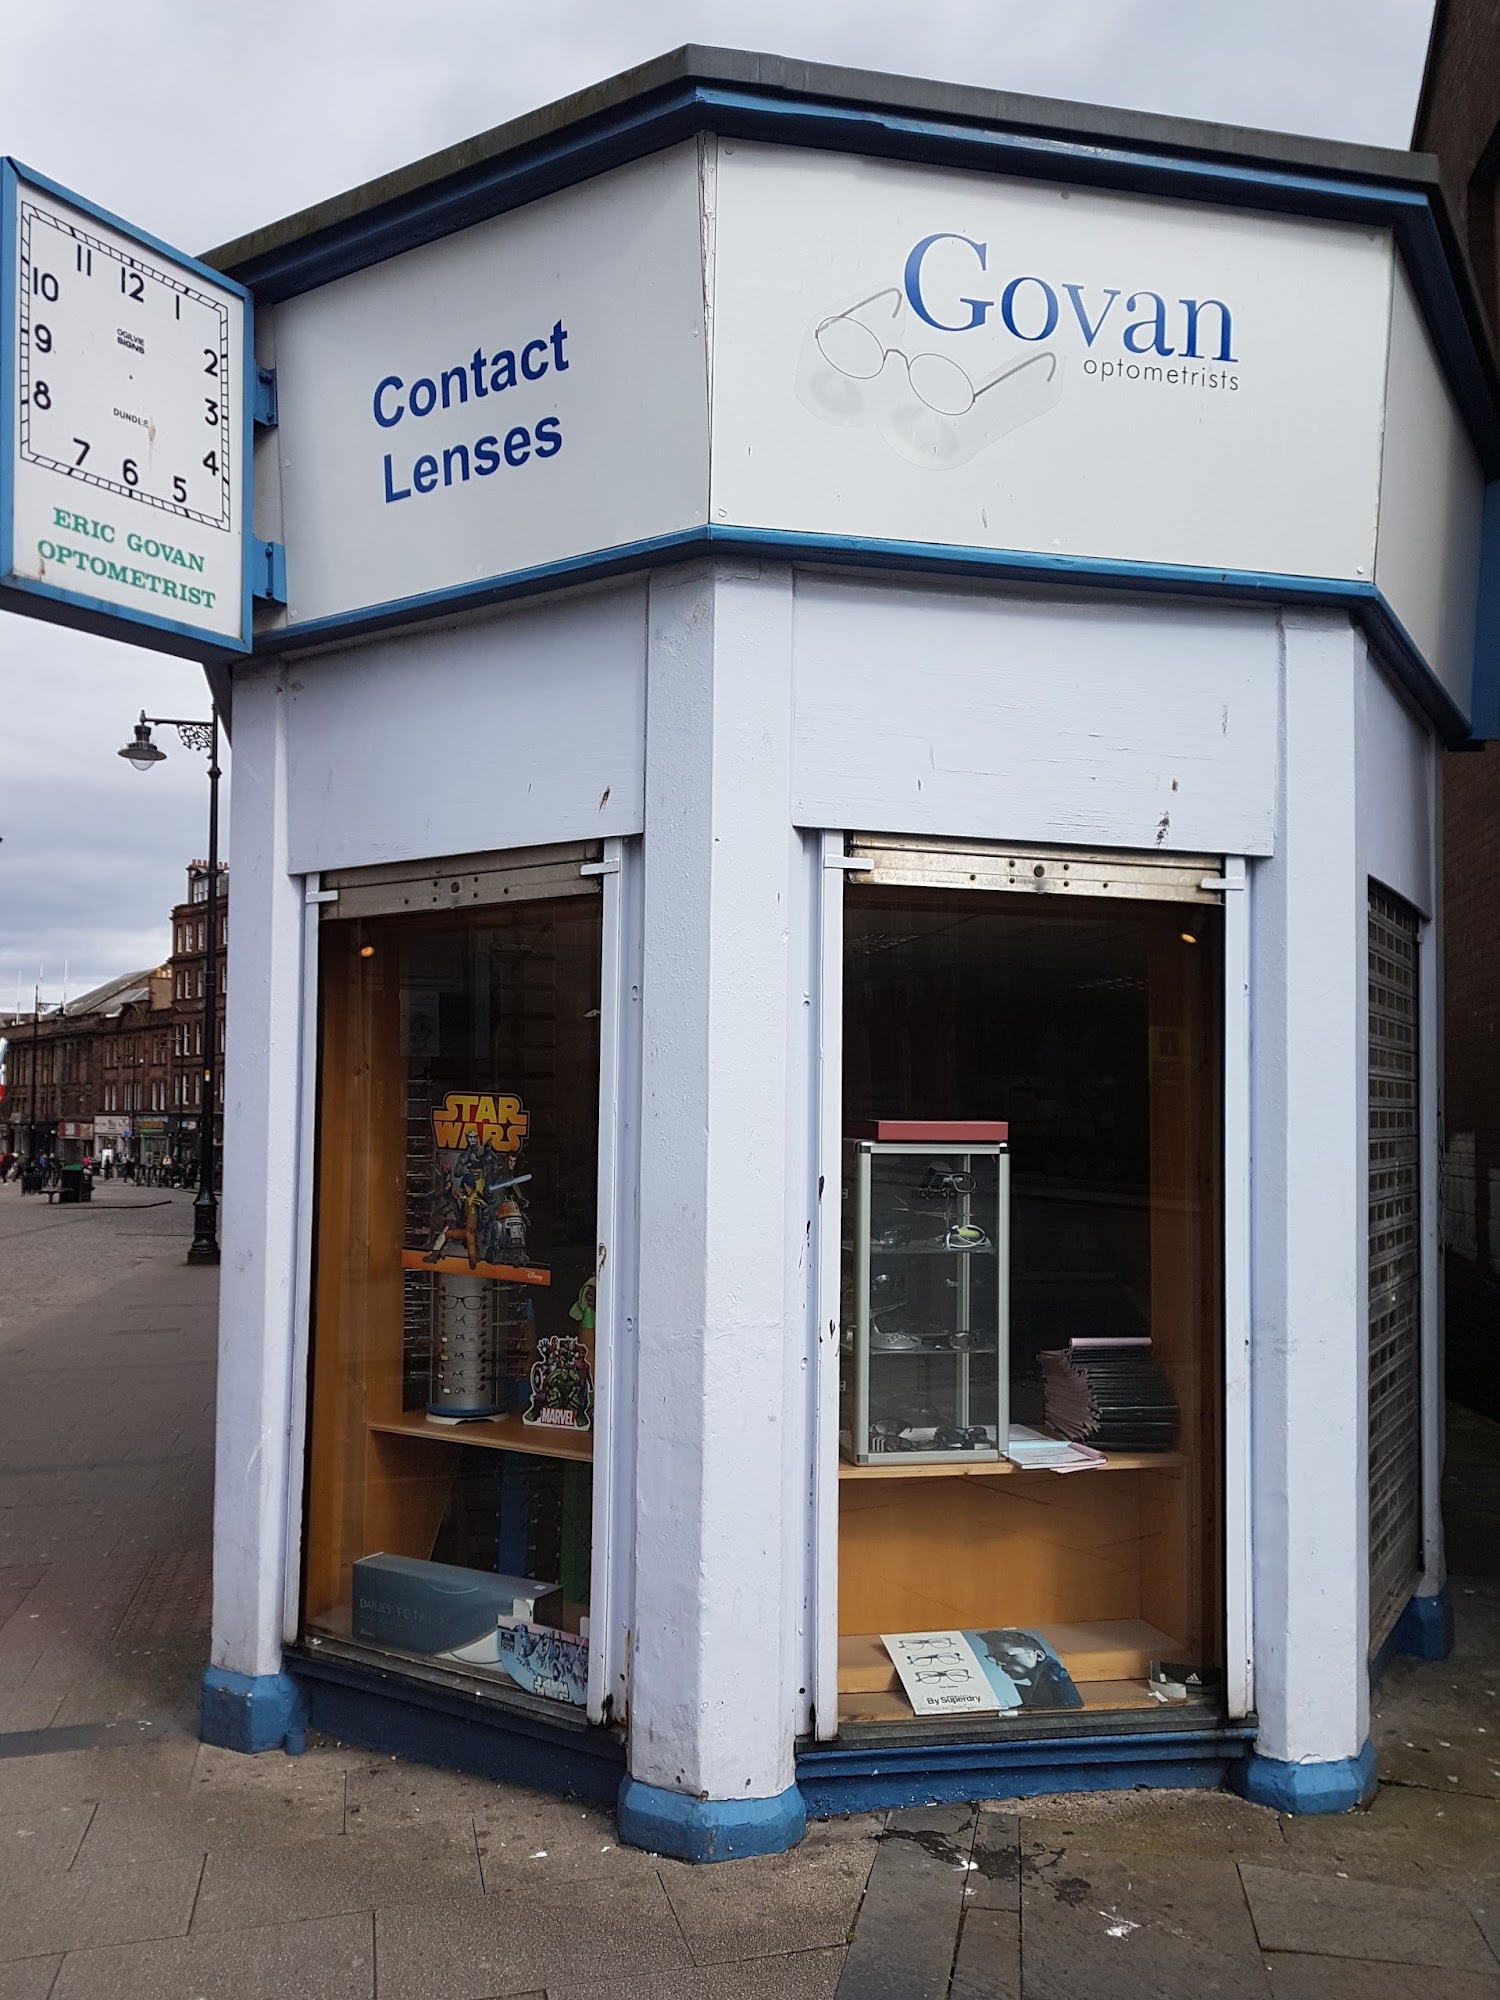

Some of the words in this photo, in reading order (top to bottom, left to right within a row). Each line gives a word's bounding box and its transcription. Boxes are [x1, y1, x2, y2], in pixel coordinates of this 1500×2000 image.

[77, 244, 91, 276] 11
[33, 266, 59, 302] 10
[121, 266, 145, 303] 12
[904, 232, 1239, 363] Govan
[175, 294, 180, 320] 1
[34, 323, 52, 353] 9
[116, 328, 145, 347] OGILVIE
[116, 336, 145, 355] SIGNS
[203, 348, 219, 377] 2
[373, 318, 570, 428] Contact
[1083, 356, 1240, 391] optometrists
[33, 380, 52, 410] 8
[204, 397, 219, 426] 3
[73, 437, 91, 466] 7
[202, 450, 219, 476] 4
[384, 416, 563, 504] Lenses
[122, 458, 139, 486] 6
[172, 475, 188, 503] 5
[53, 506, 116, 543] ERIC
[127, 532, 205, 573] GOVAN
[37, 539, 216, 609] OPTOMETRIST
[433, 1094, 527, 1124] STAR
[433, 1120, 527, 1153] WARS
[540, 1407, 575, 1426] MARVEL
[926, 1697, 939, 1706] By
